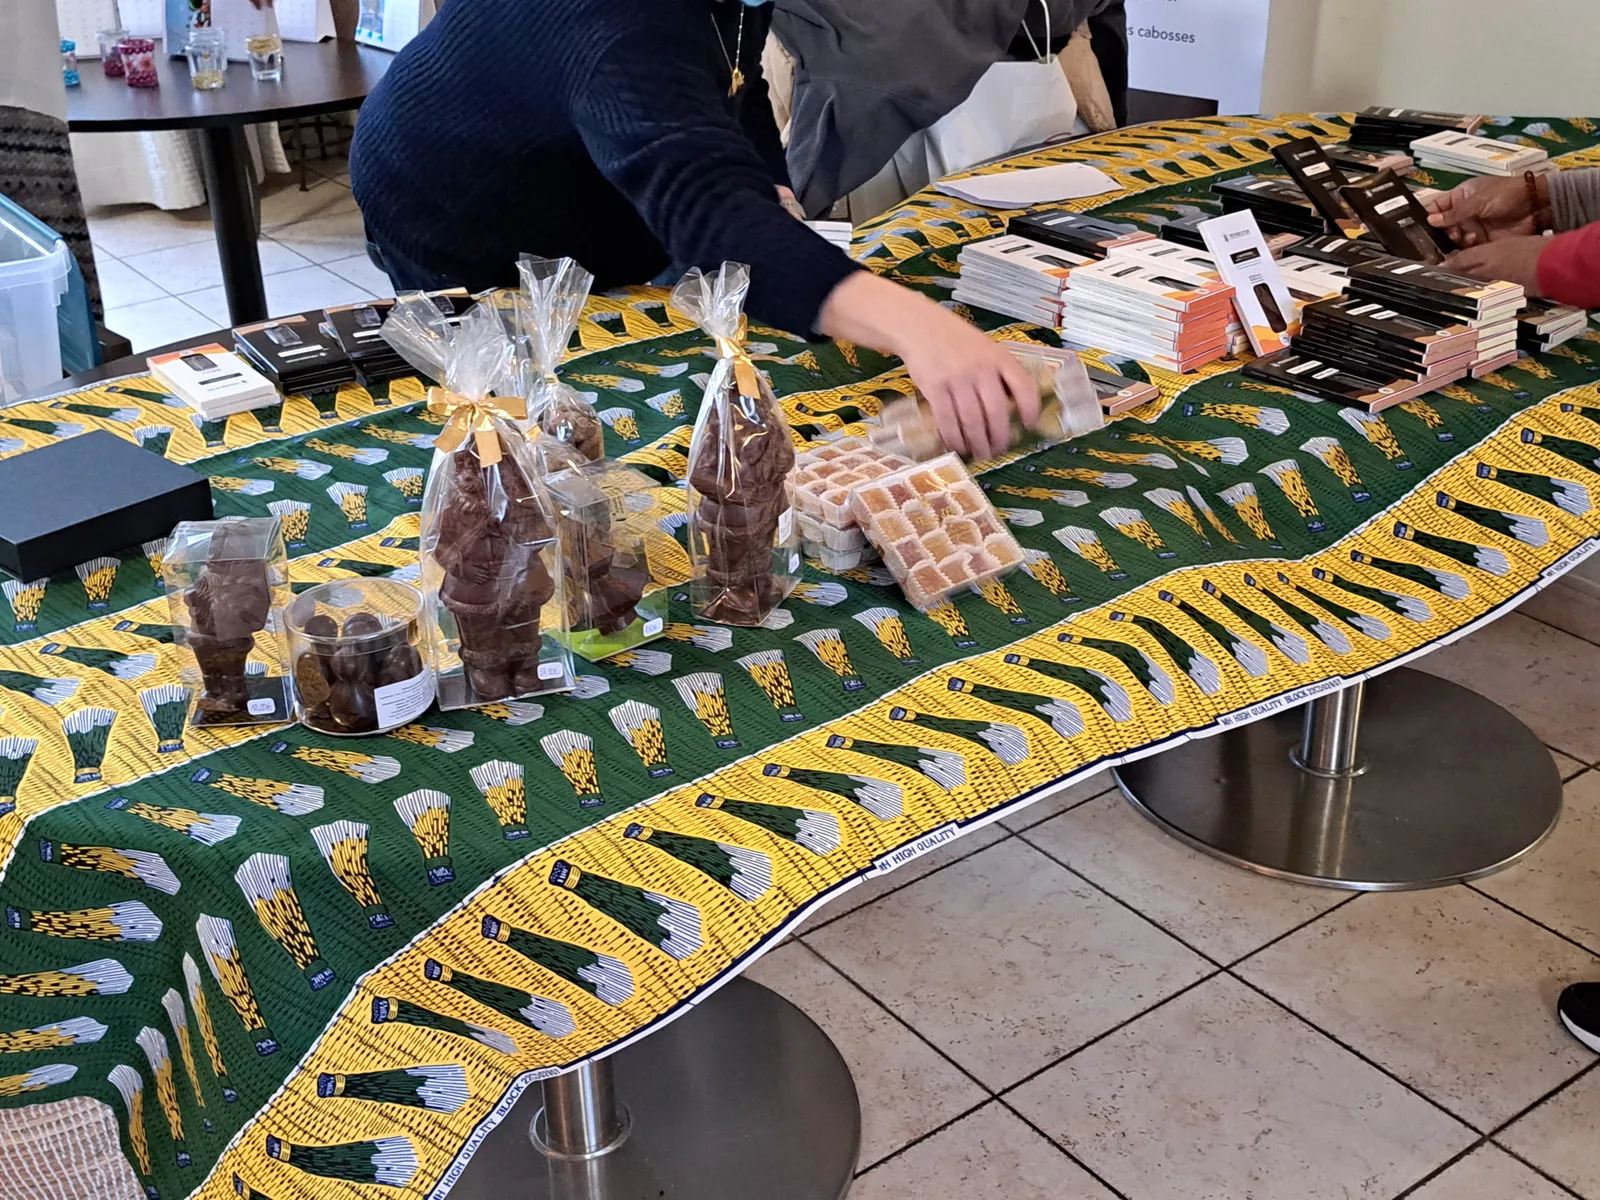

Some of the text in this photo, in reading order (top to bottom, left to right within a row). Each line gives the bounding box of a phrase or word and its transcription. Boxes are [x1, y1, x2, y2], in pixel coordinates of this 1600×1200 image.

[1137, 25, 1196, 43] cabosses
[1568, 542, 1595, 561] QUALITY
[1233, 712, 1252, 723] HIGH
[1251, 699, 1283, 716] QUALITY
[1286, 692, 1308, 704] BLOCK
[892, 847, 917, 864] HIGH
[917, 828, 956, 851] QUALITY
[443, 1161, 465, 1188] HIGH
[463, 1118, 497, 1160] QUALITY
[496, 1083, 524, 1117] BLOCK
